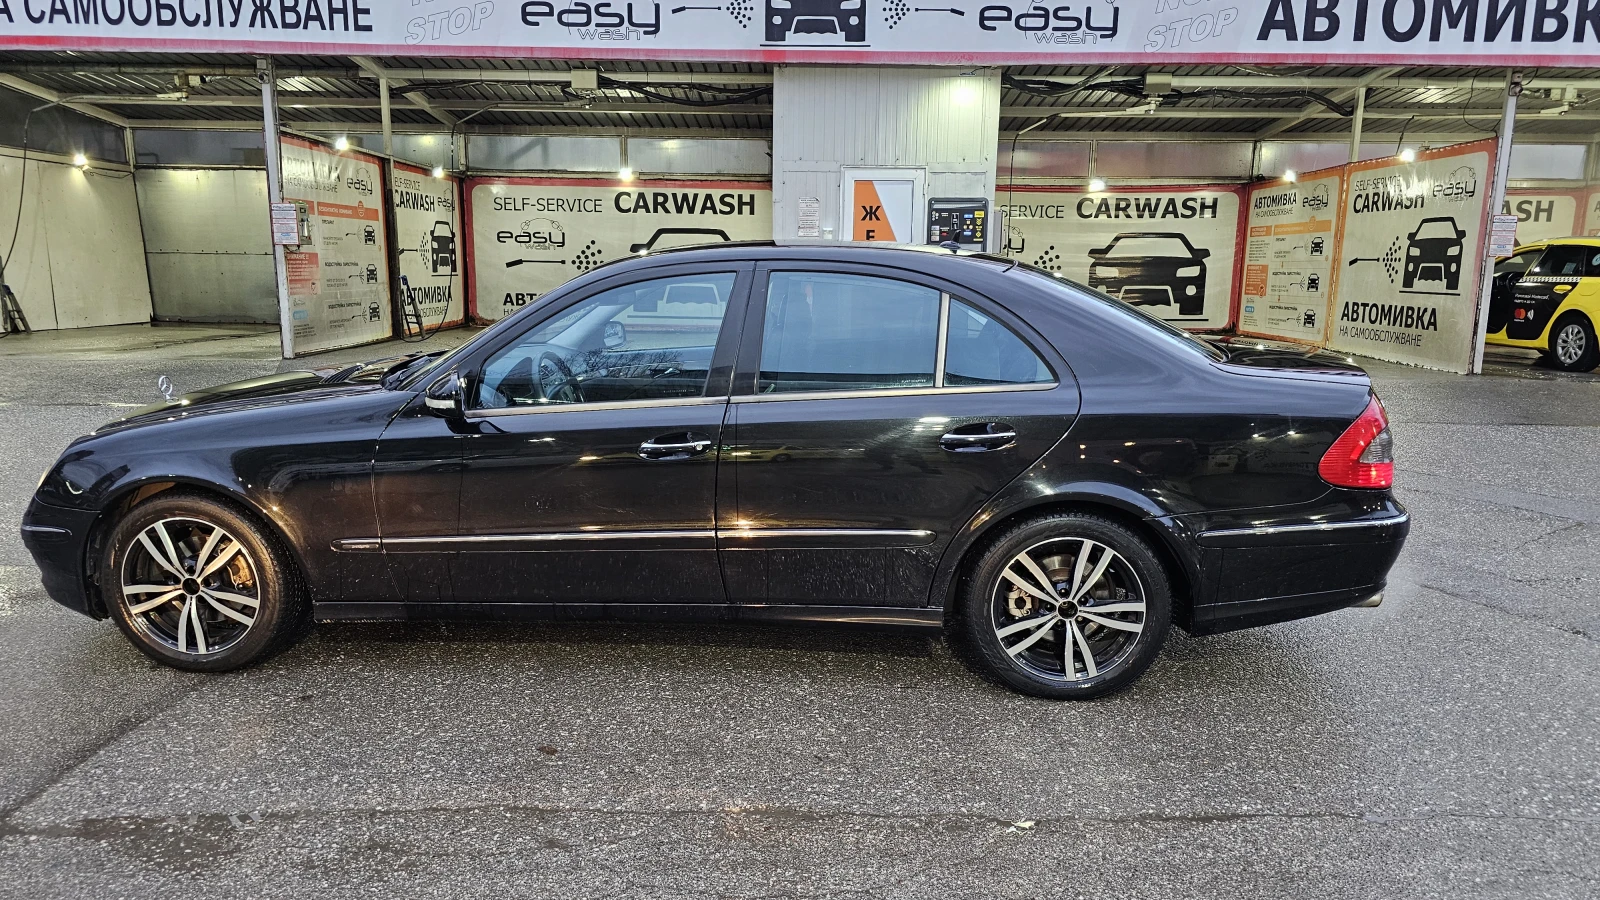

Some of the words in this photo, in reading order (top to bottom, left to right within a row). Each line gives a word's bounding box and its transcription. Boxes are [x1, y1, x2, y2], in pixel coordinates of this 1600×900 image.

[405, 1, 494, 45] STOP
[521, 1, 660, 35] easy
[979, 5, 1119, 39] easy
[577, 27, 640, 40] wash
[1034, 30, 1097, 44] wash
[1144, 7, 1238, 53] STOP
[346, 177, 373, 195] easy
[1433, 179, 1476, 198] easy
[493, 197, 602, 213] SELF-SERVICE
[614, 192, 755, 216] CARWASH
[1076, 197, 1218, 219] CARWASH
[1254, 192, 1297, 209] АВТОМИВКА
[1303, 194, 1329, 208] easy
[1353, 188, 1425, 214] CARWASH
[861, 205, 881, 221] Ж
[497, 231, 565, 247] easy
[1341, 301, 1438, 331] АВТОМИВКА
[1339, 325, 1349, 337] НА
[1350, 326, 1422, 347] САМООБСЛУЖВАНЕ
